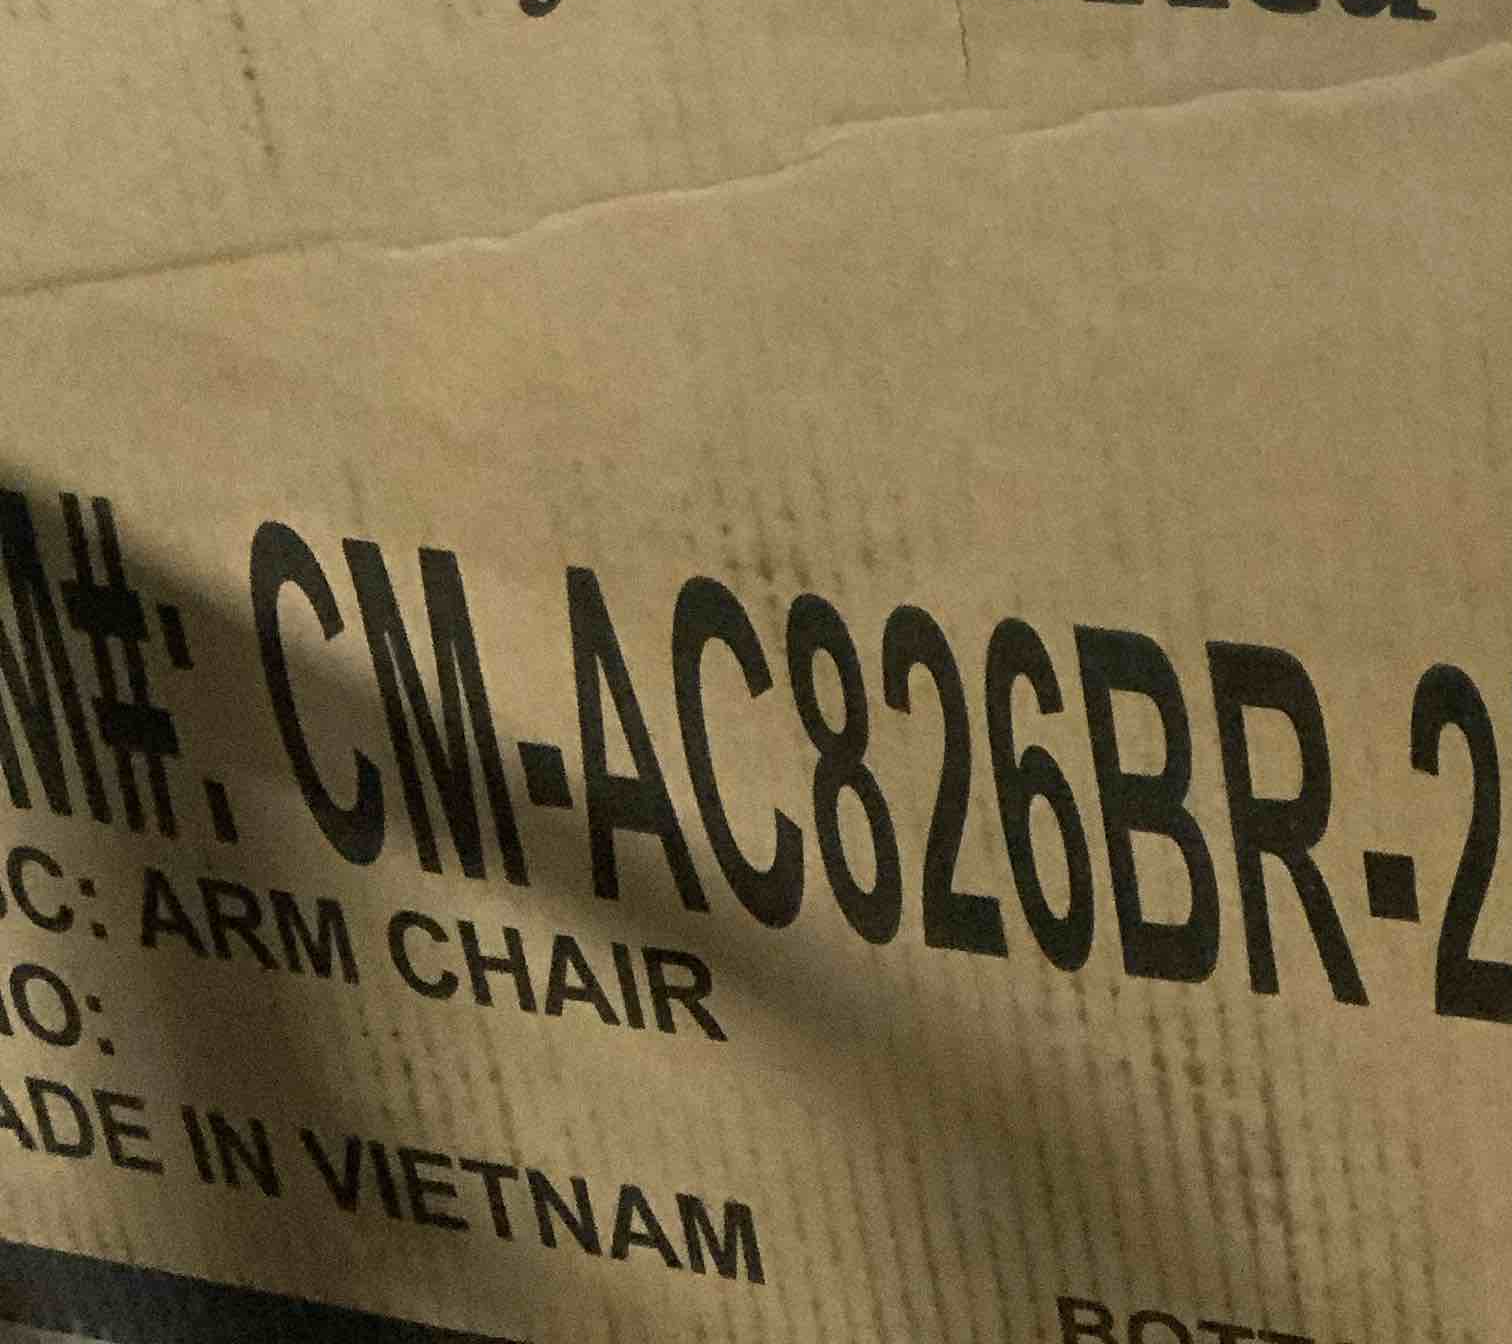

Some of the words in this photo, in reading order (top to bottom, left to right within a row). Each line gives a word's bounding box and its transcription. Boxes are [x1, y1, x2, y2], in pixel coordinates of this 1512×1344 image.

[0, 845, 108, 940] C:
[138, 867, 361, 984] ARM
[388, 909, 729, 1042] CHAIR
[0, 963, 115, 1056] O:
[182, 1104, 281, 1198] IN
[301, 1127, 766, 1285] VIETNAM
